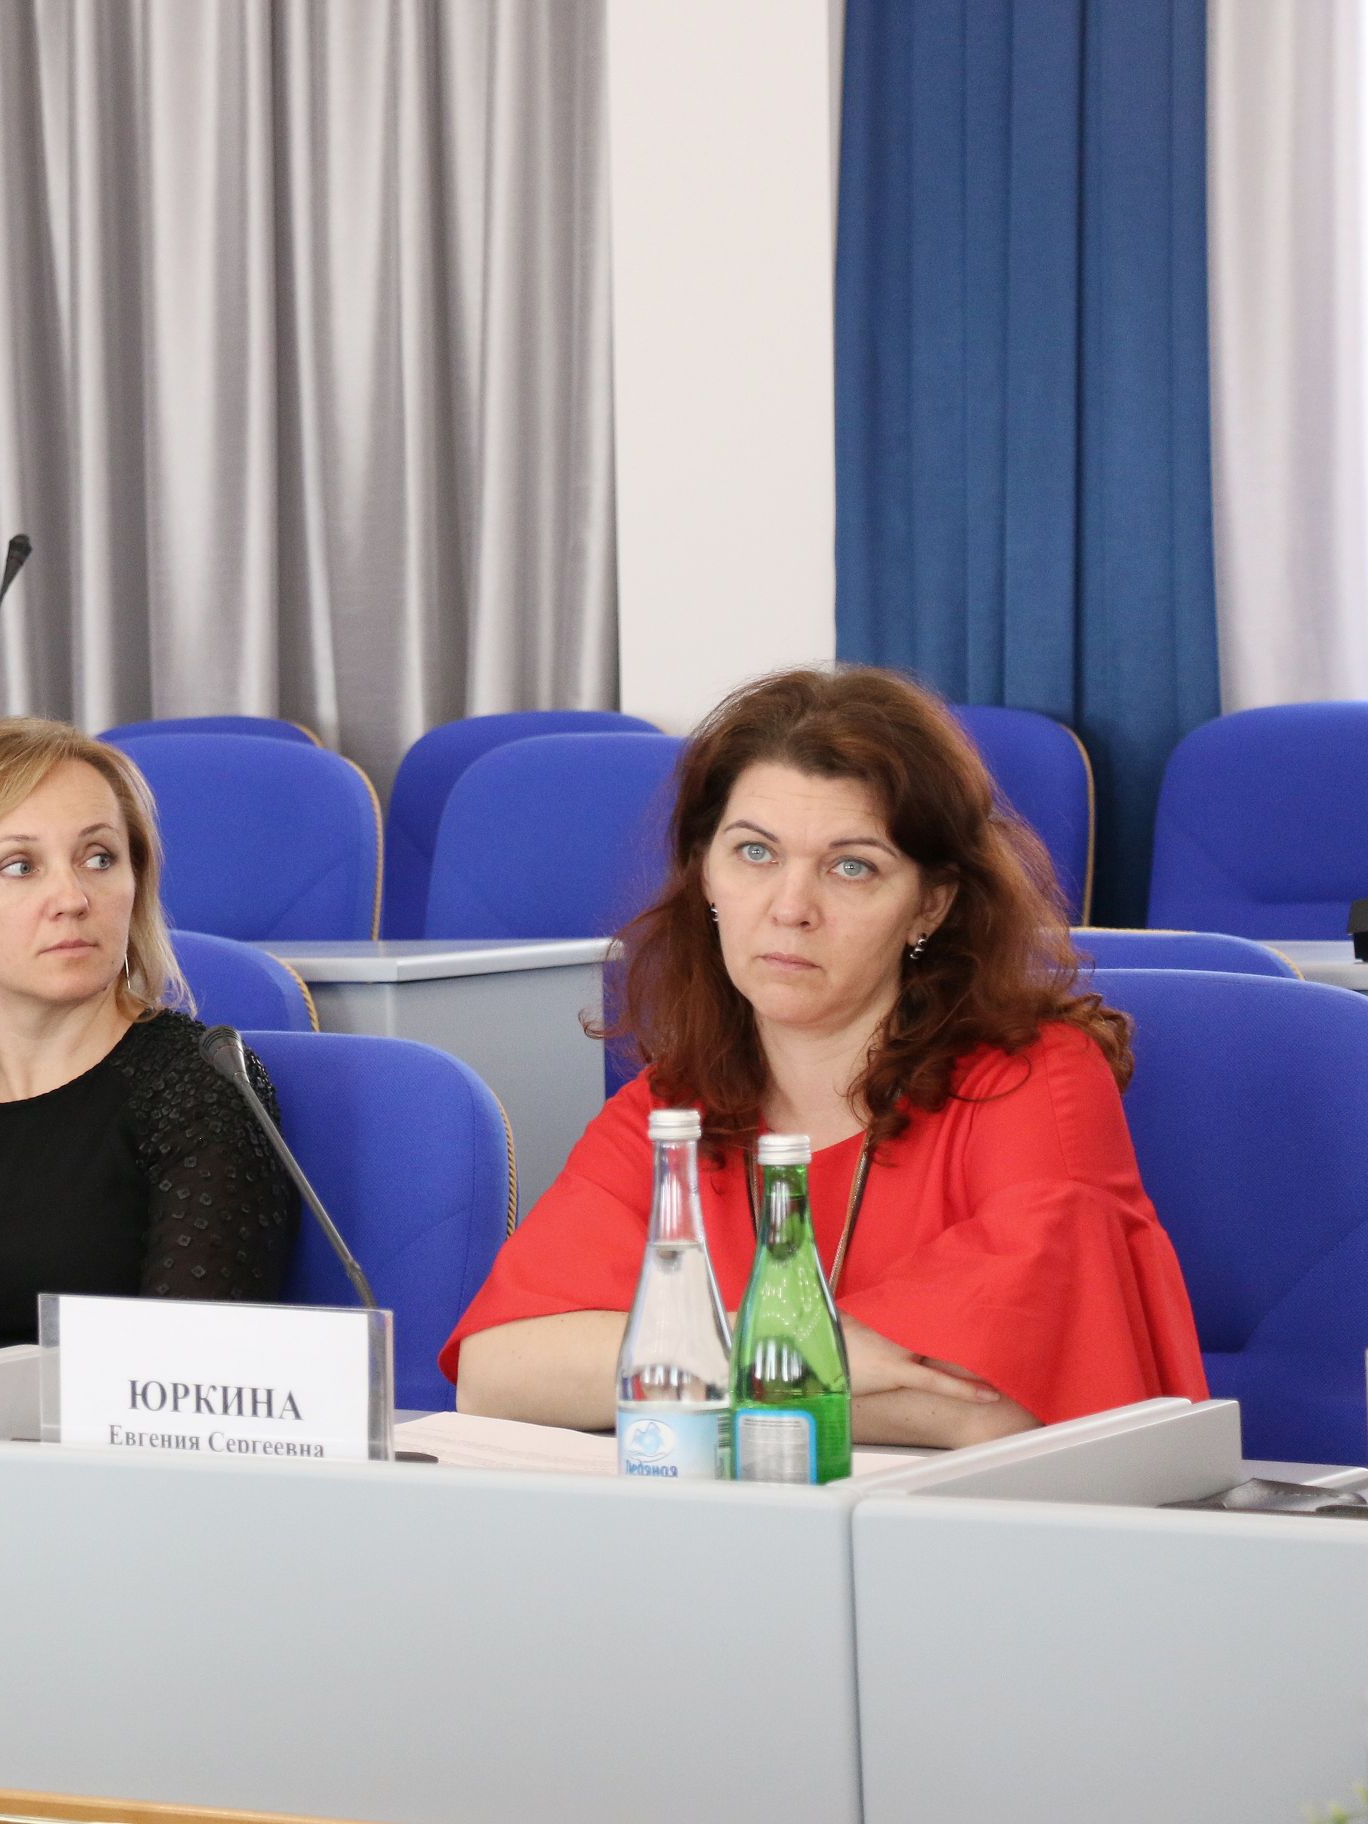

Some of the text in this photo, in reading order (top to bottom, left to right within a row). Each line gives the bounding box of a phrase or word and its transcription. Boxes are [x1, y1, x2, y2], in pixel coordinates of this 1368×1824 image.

[128, 1379, 303, 1420] ЮРКИНА
[108, 1424, 324, 1458] Евгения Сергеевна
